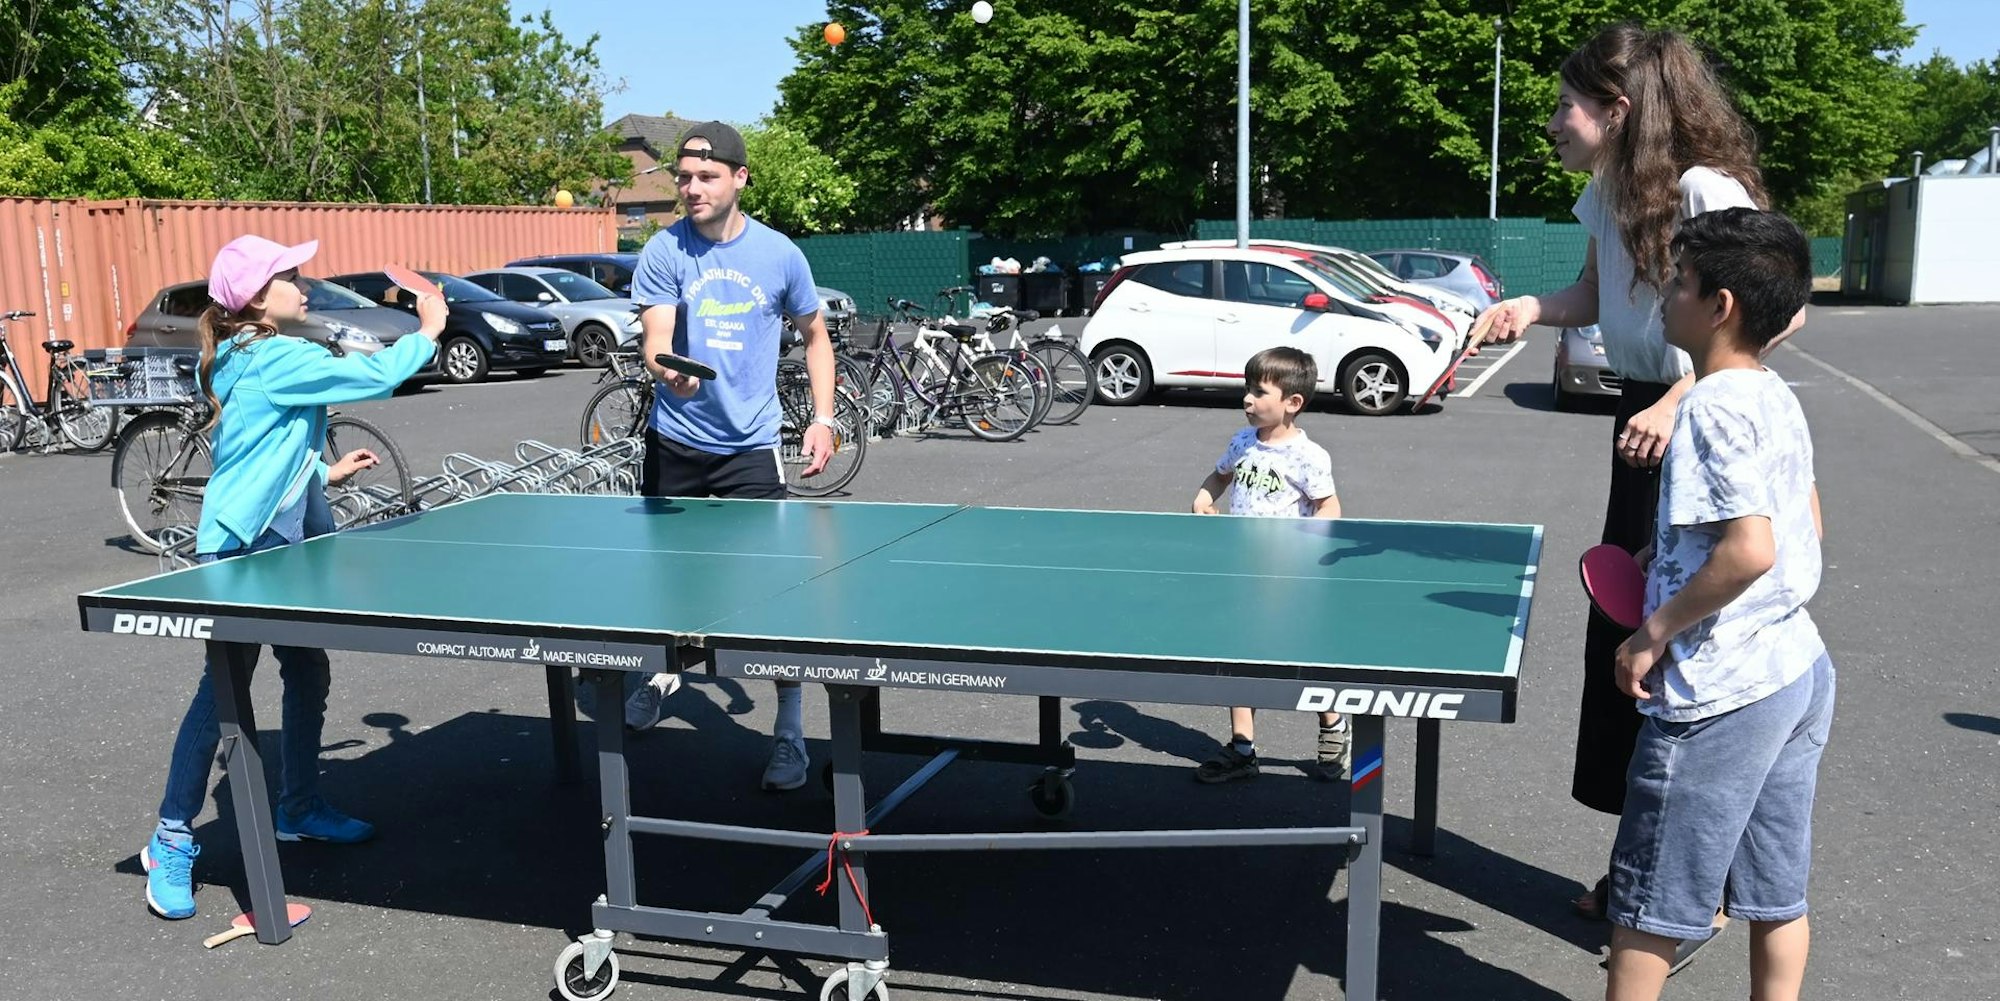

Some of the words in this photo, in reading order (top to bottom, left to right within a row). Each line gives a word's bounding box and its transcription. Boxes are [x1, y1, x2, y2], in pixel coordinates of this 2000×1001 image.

[703, 268, 752, 288] ATHLETIC
[719, 321, 746, 331] OSAKA
[112, 613, 215, 640] DONIC
[416, 642, 466, 656] COMPACT
[468, 645, 517, 659] AUTOMAT
[543, 651, 574, 664] MADE
[575, 652, 587, 664] IN
[587, 652, 643, 668] GERMANY
[744, 663, 801, 677] COMPACT
[803, 666, 860, 681] AUTOMAT
[890, 671, 927, 685] MADE
[928, 672, 941, 685] IN
[942, 673, 1007, 689] GERMANY
[1295, 686, 1466, 720] DONIC
